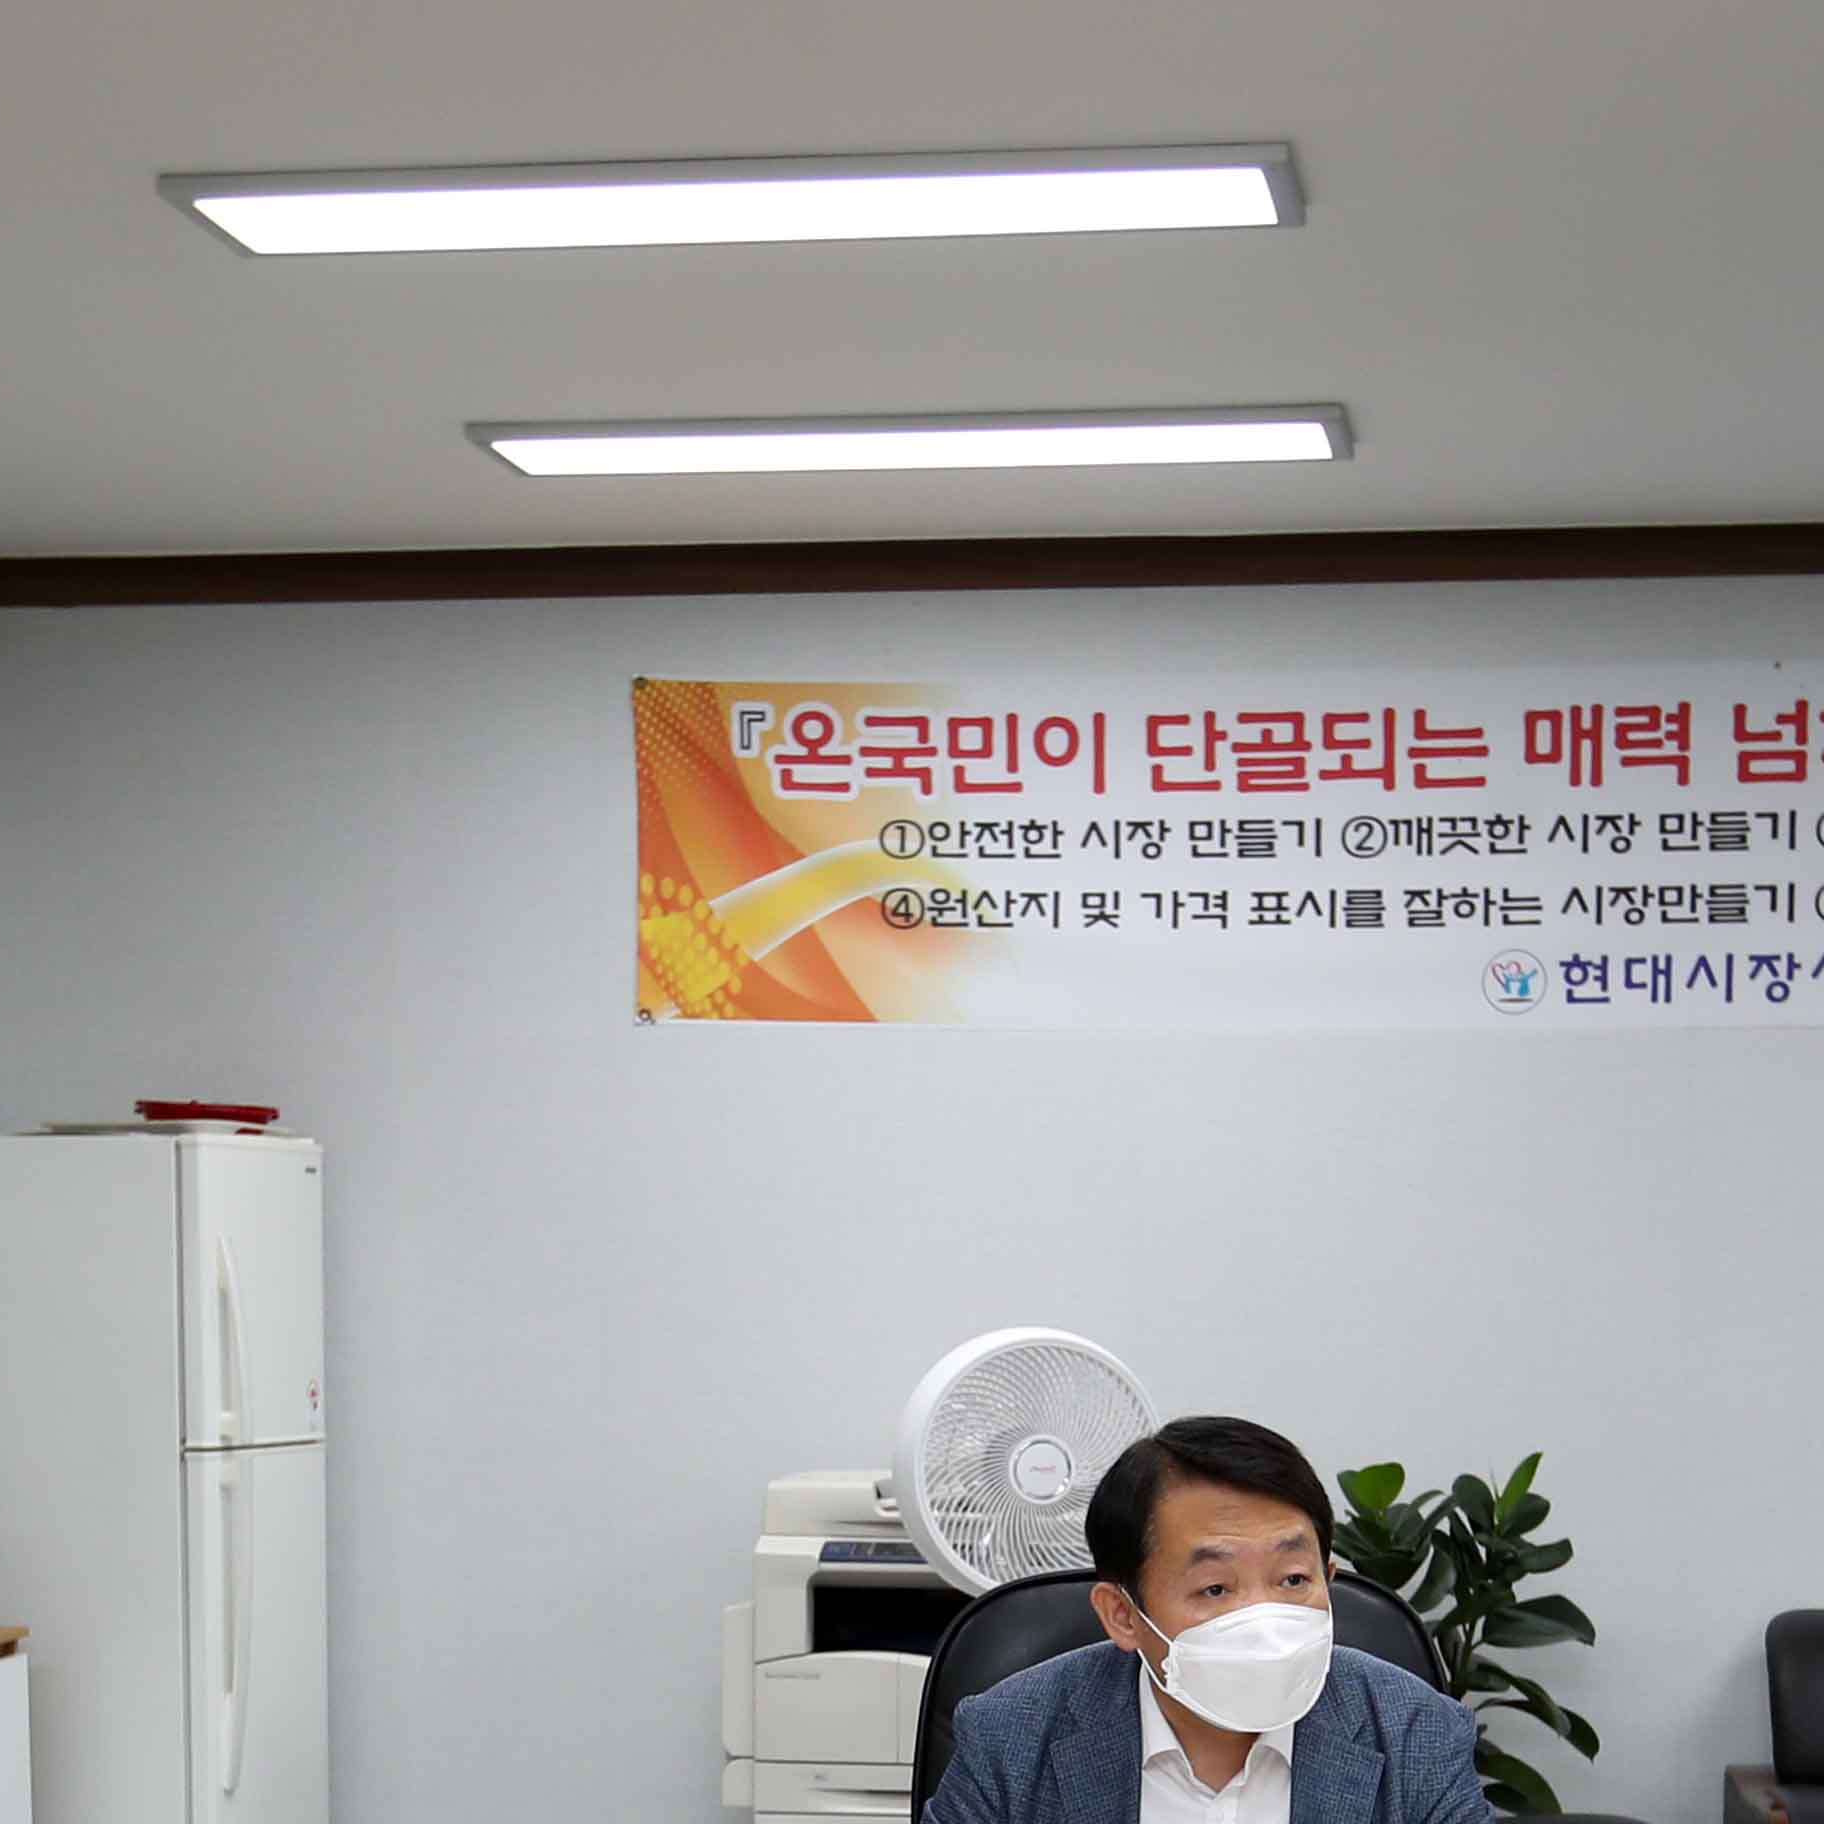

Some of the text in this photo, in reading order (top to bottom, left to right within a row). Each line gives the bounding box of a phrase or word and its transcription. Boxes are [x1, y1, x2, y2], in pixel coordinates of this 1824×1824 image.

[1147, 707, 1489, 793] 단골되는
[1524, 701, 1691, 787] 매력
[1081, 819, 1170, 860] 시장
[1188, 817, 1322, 859] 만들기
[1547, 812, 1642, 854] 시장
[1658, 809, 1797, 852] 만들기
[1081, 890, 1120, 928] 및
[1140, 890, 1228, 929] 가격
[1248, 889, 1386, 929] 표시를
[1403, 886, 1543, 928] 잘하는
[1561, 882, 1796, 926] 시장만들기
